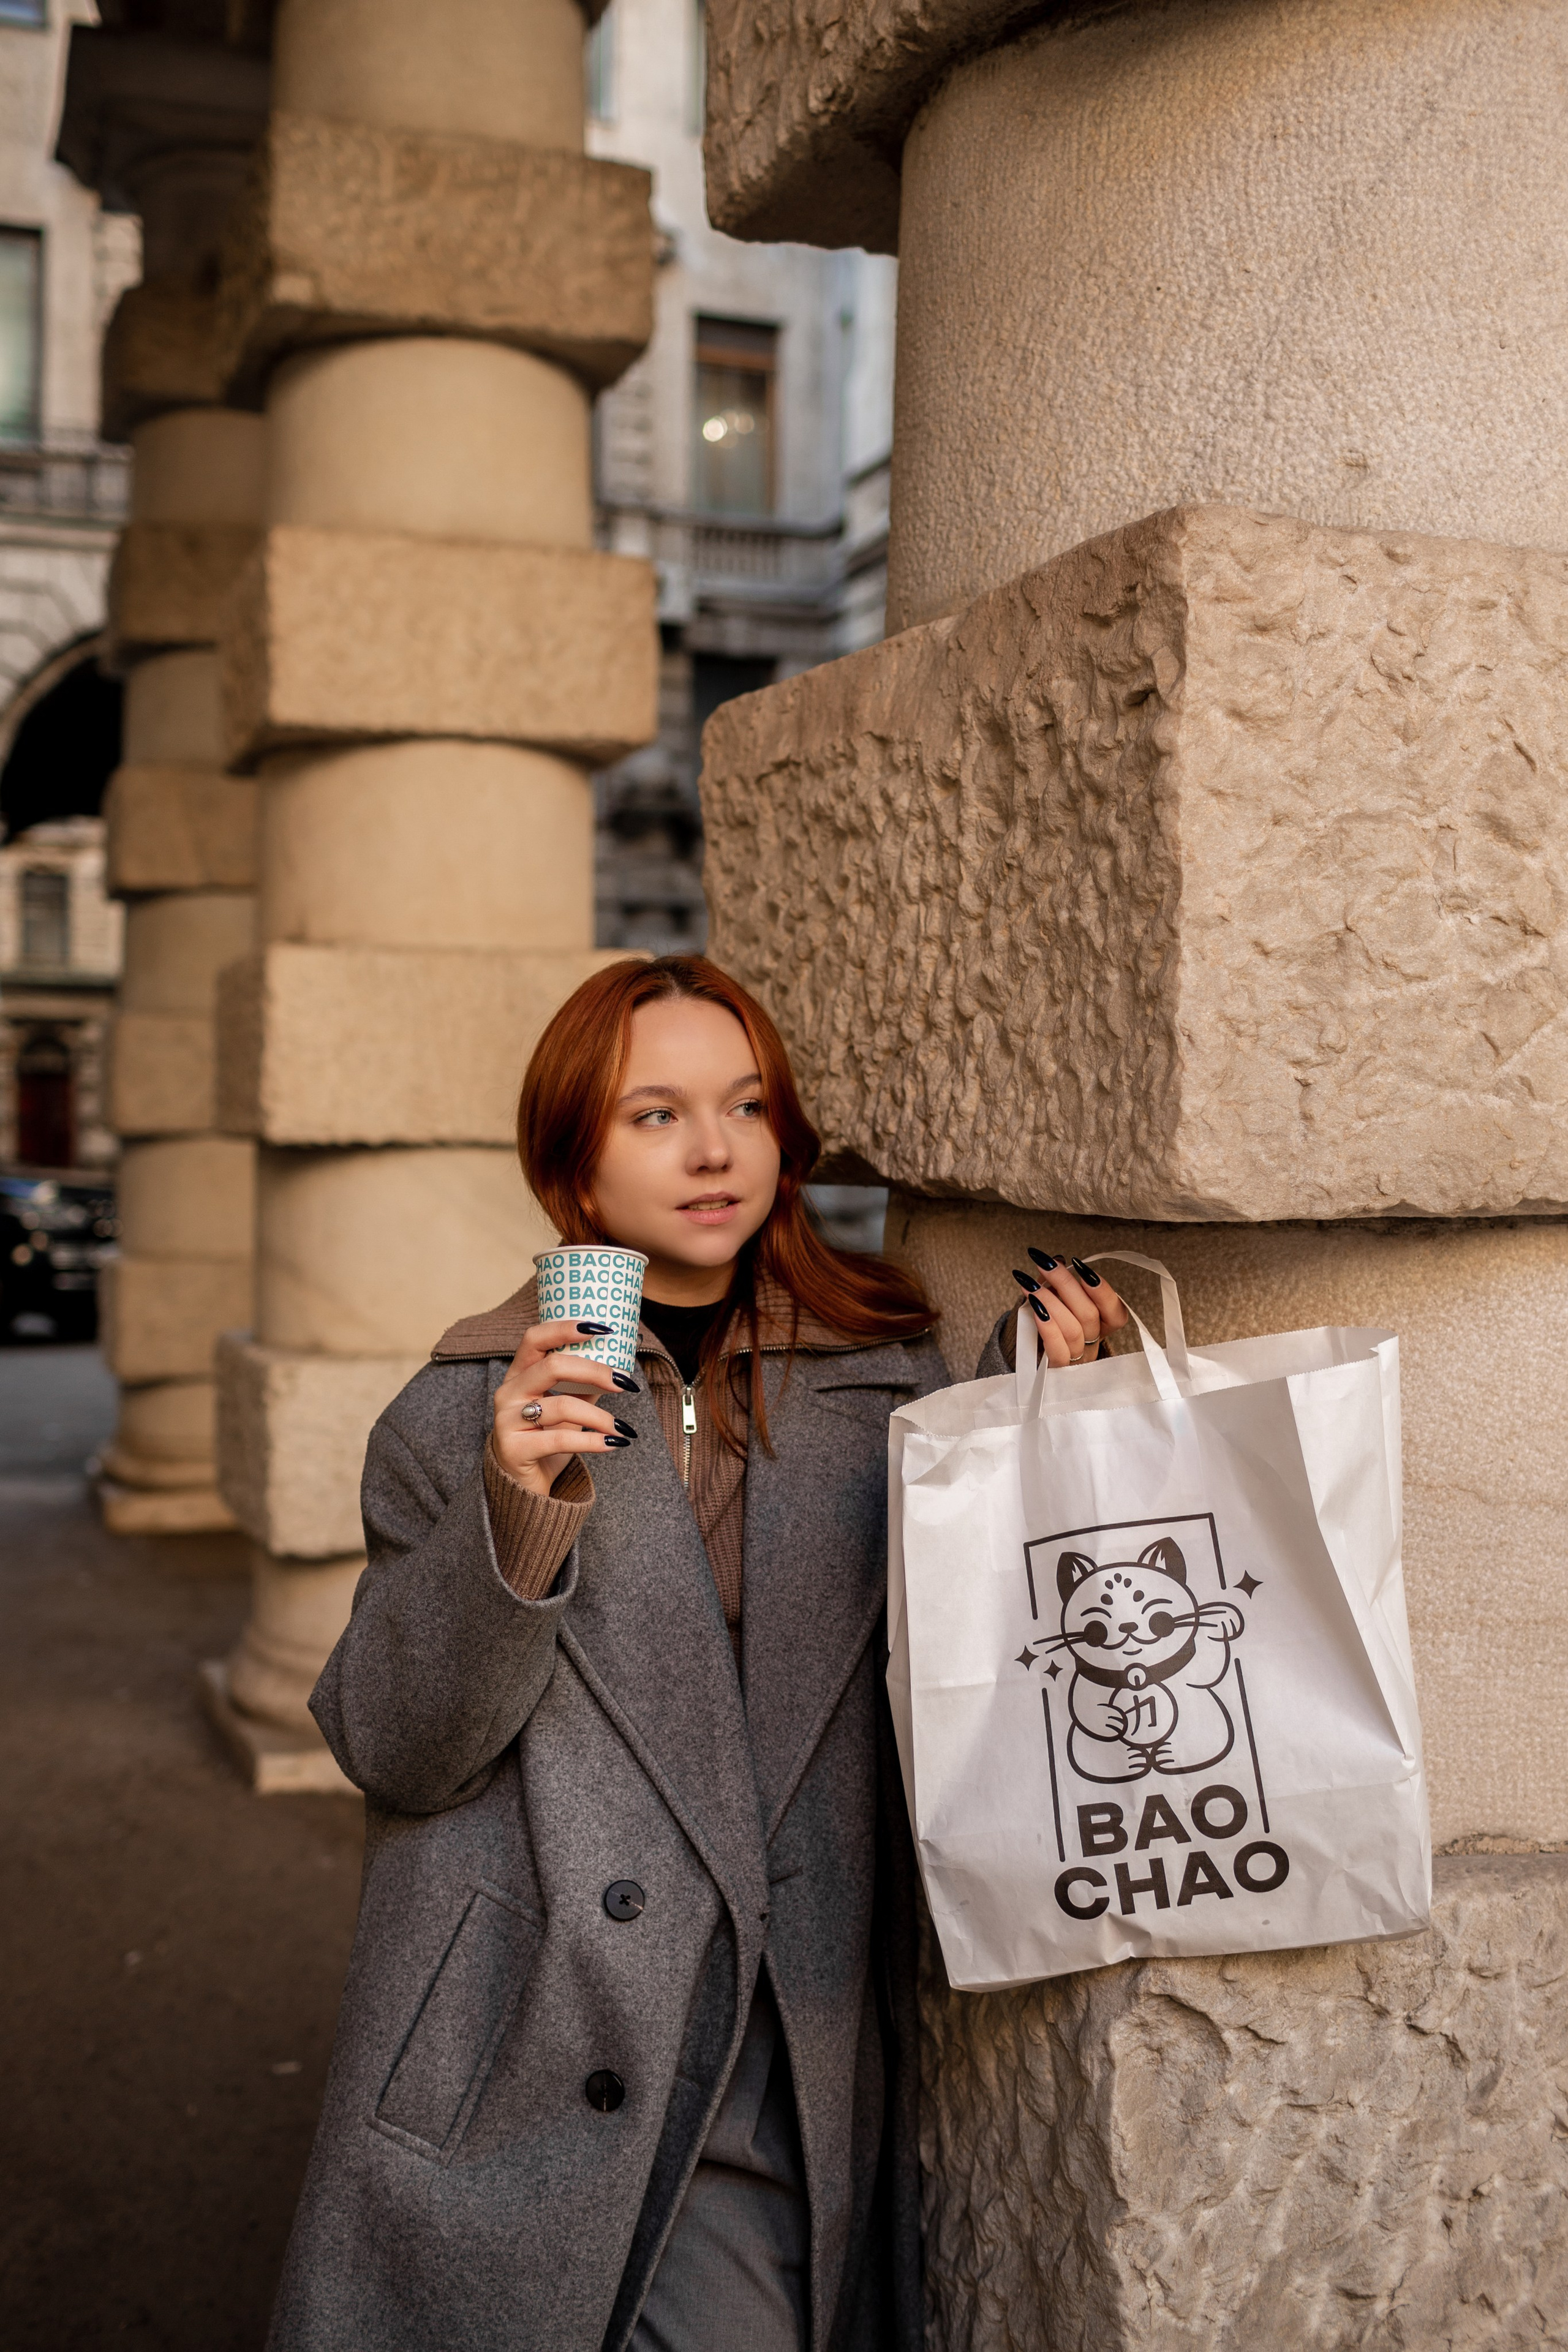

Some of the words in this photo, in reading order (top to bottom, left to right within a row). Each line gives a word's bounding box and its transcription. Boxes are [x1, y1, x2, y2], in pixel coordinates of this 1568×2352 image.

[537, 1254, 564, 1274] HAO
[569, 1253, 611, 1267] BAO
[538, 1271, 565, 1291] HAO
[569, 1270, 609, 1283] BAO
[538, 1287, 565, 1306] HAO
[569, 1286, 608, 1300] BAO
[539, 1305, 565, 1323] HAO
[570, 1303, 607, 1317] BAO
[1076, 1785, 1248, 1858] BAO
[1054, 1841, 1289, 1920] CHAO
